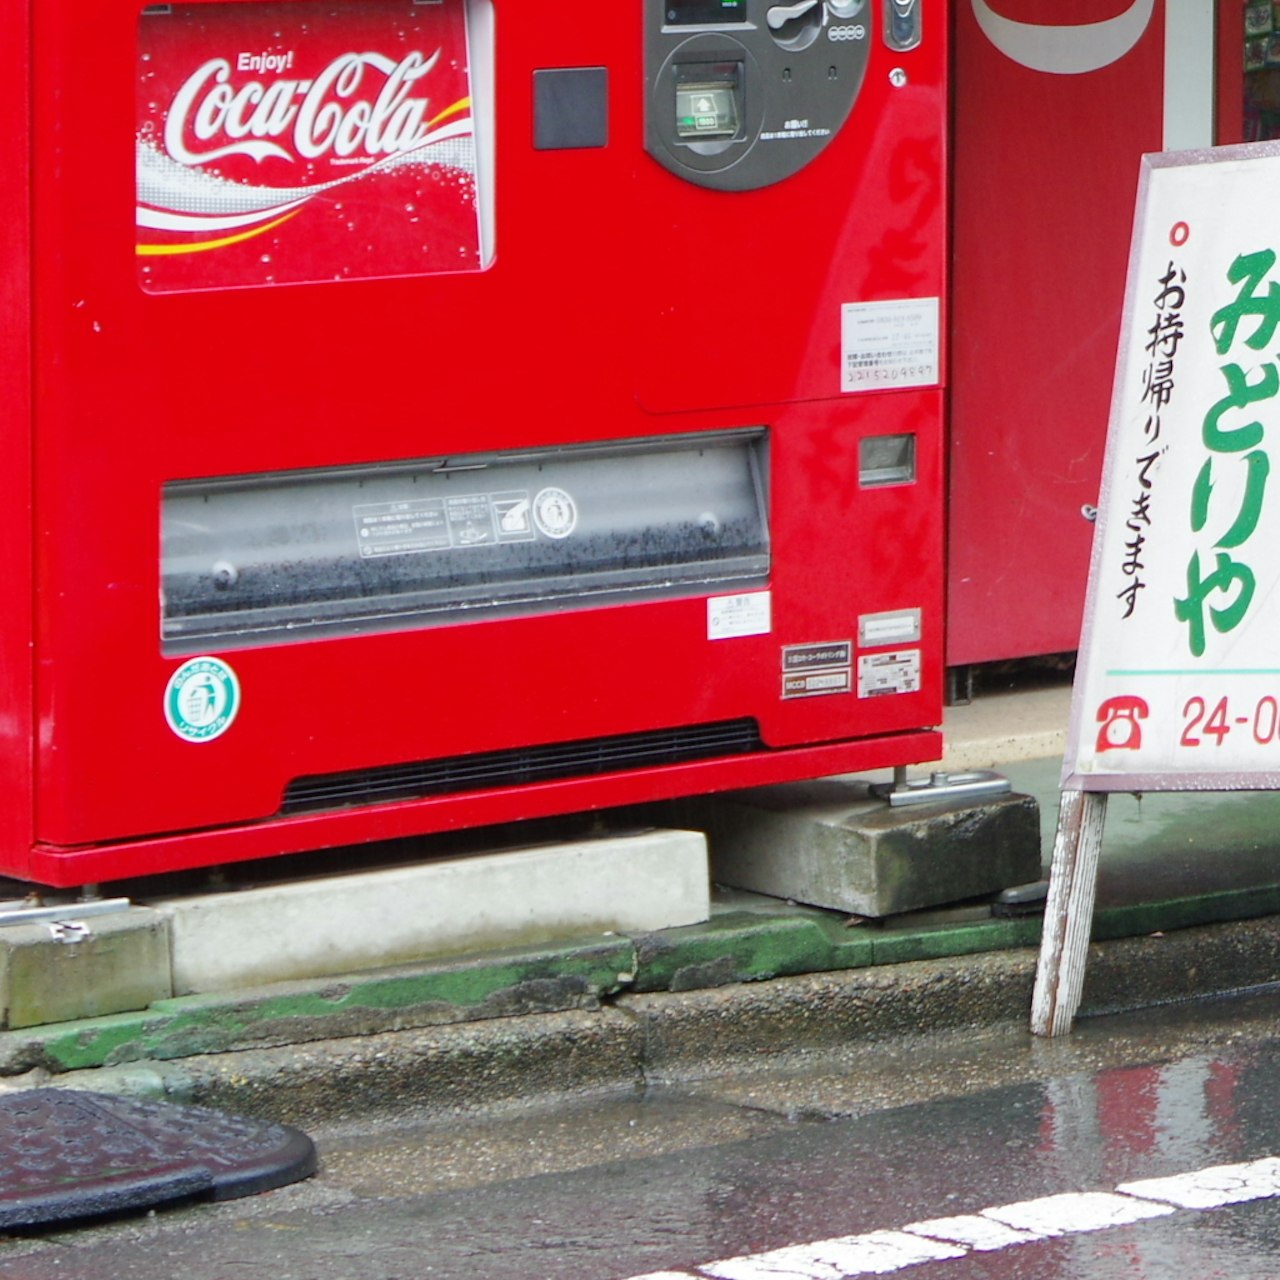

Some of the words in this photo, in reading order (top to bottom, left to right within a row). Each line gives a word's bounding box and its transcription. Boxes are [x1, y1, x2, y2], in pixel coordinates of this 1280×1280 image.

[164, 46, 441, 166] Coca-Cola
[237, 51, 294, 74] Enjoy!
[1116, 260, 1189, 619] お持帰りできます
